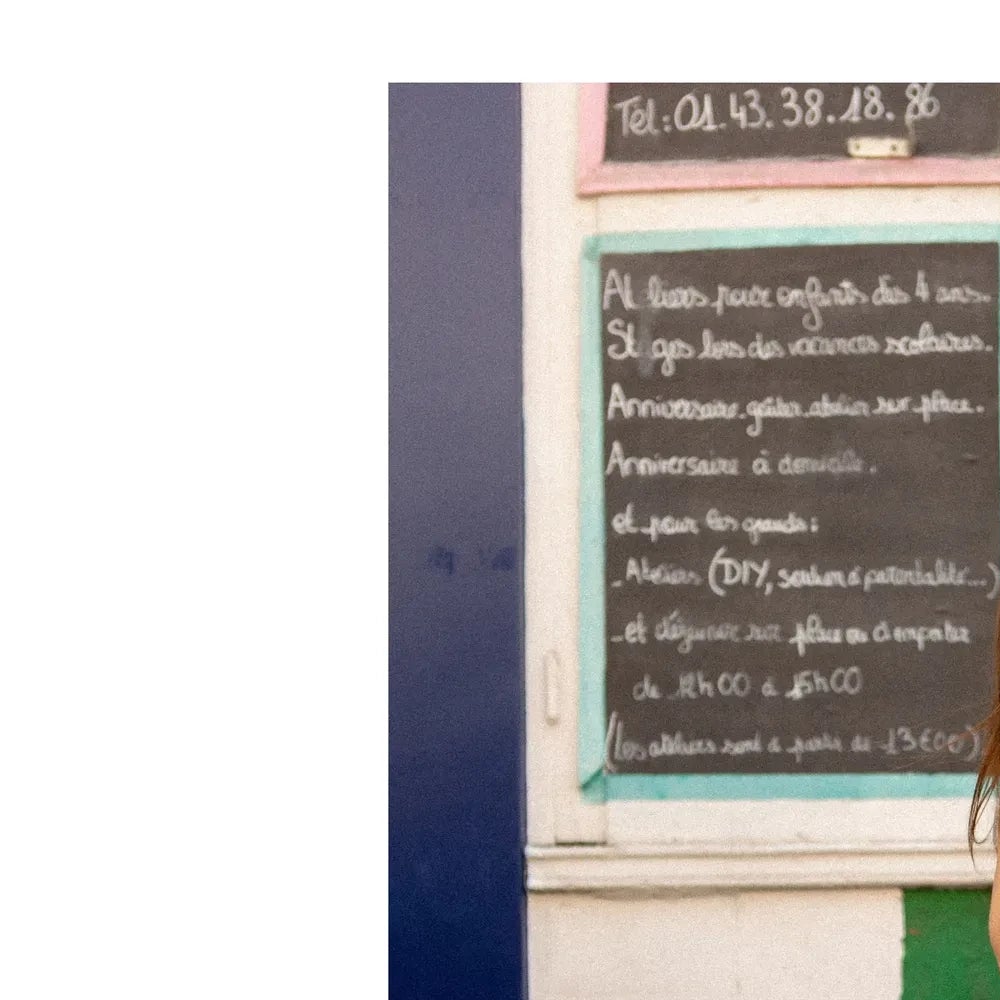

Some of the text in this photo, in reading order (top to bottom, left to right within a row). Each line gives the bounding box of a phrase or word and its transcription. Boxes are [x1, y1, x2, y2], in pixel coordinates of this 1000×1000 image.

[711, 284, 776, 316] pour
[915, 269, 930, 302] 4
[605, 439, 740, 478] Anniversaire
[612, 502, 641, 535] et
[708, 546, 774, 597] (DIY,
